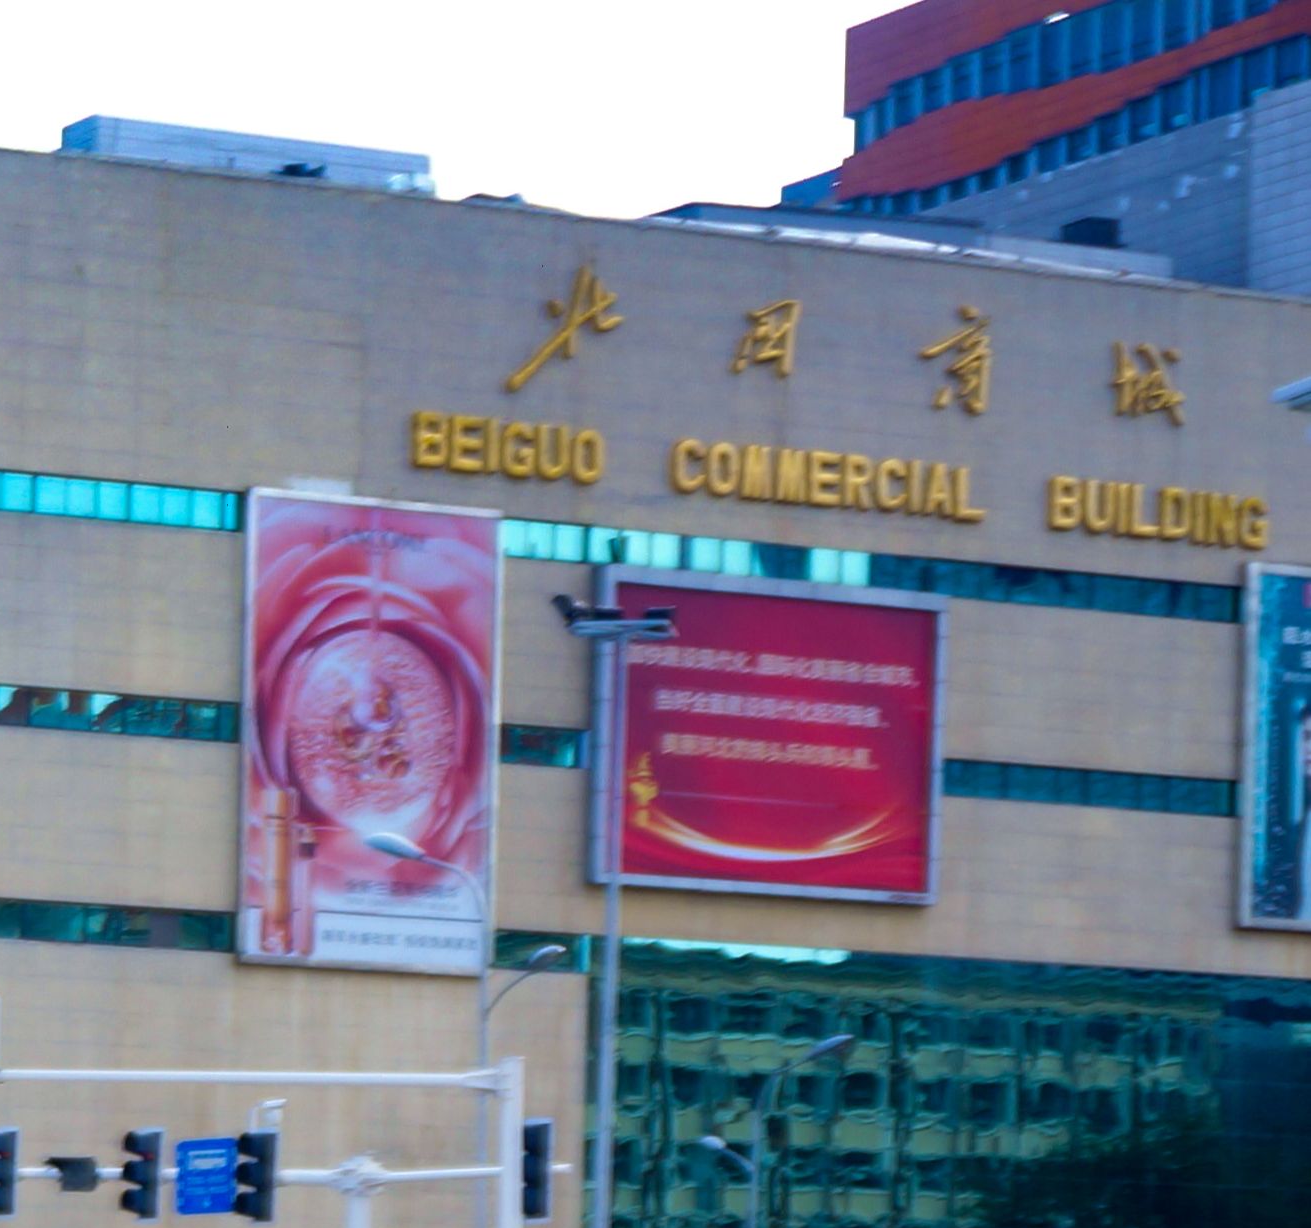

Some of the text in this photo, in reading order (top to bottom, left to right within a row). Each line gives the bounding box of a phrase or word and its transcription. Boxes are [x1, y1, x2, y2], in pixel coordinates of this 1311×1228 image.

[505, 261, 1187, 428] 北国商城
[411, 409, 1272, 551] BEIGUO COMMERCIAL BUILDING
